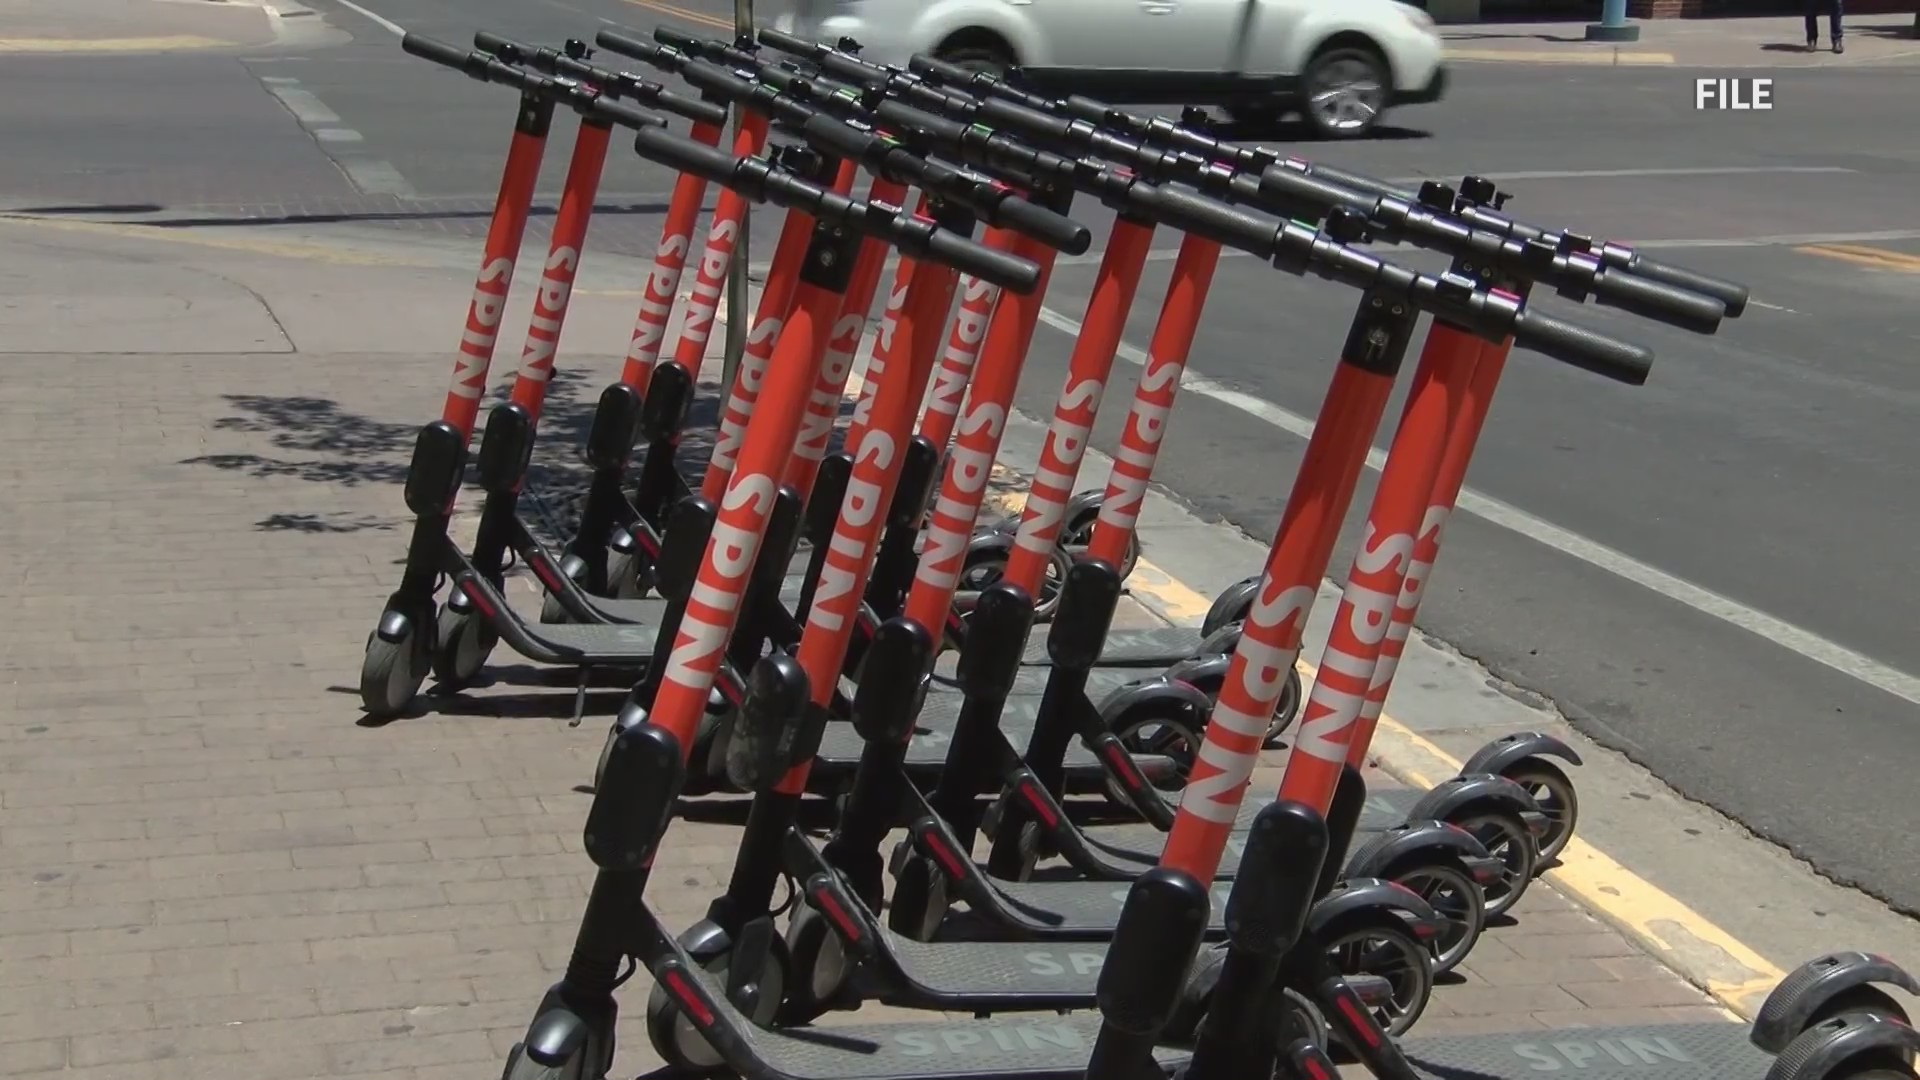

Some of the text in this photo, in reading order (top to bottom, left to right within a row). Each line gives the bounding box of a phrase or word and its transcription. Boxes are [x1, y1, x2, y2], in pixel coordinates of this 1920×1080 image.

[449, 253, 512, 398] SPIN
[518, 239, 577, 381] SPIN
[626, 231, 688, 363] SPIN
[681, 217, 737, 342] SPIN
[927, 274, 997, 415] SPIN
[793, 314, 864, 460] SPIN
[1098, 355, 1181, 528] SPIN
[807, 429, 895, 632] SPIN
[915, 394, 1004, 588] SPIN
[1014, 371, 1103, 554] SPIN
[664, 466, 775, 689] SPIN
[1294, 520, 1414, 763] SPIN
[1181, 571, 1315, 823] SPIN
[894, 1024, 1083, 1057] SPIN
[1512, 1036, 1692, 1071] SPIN
